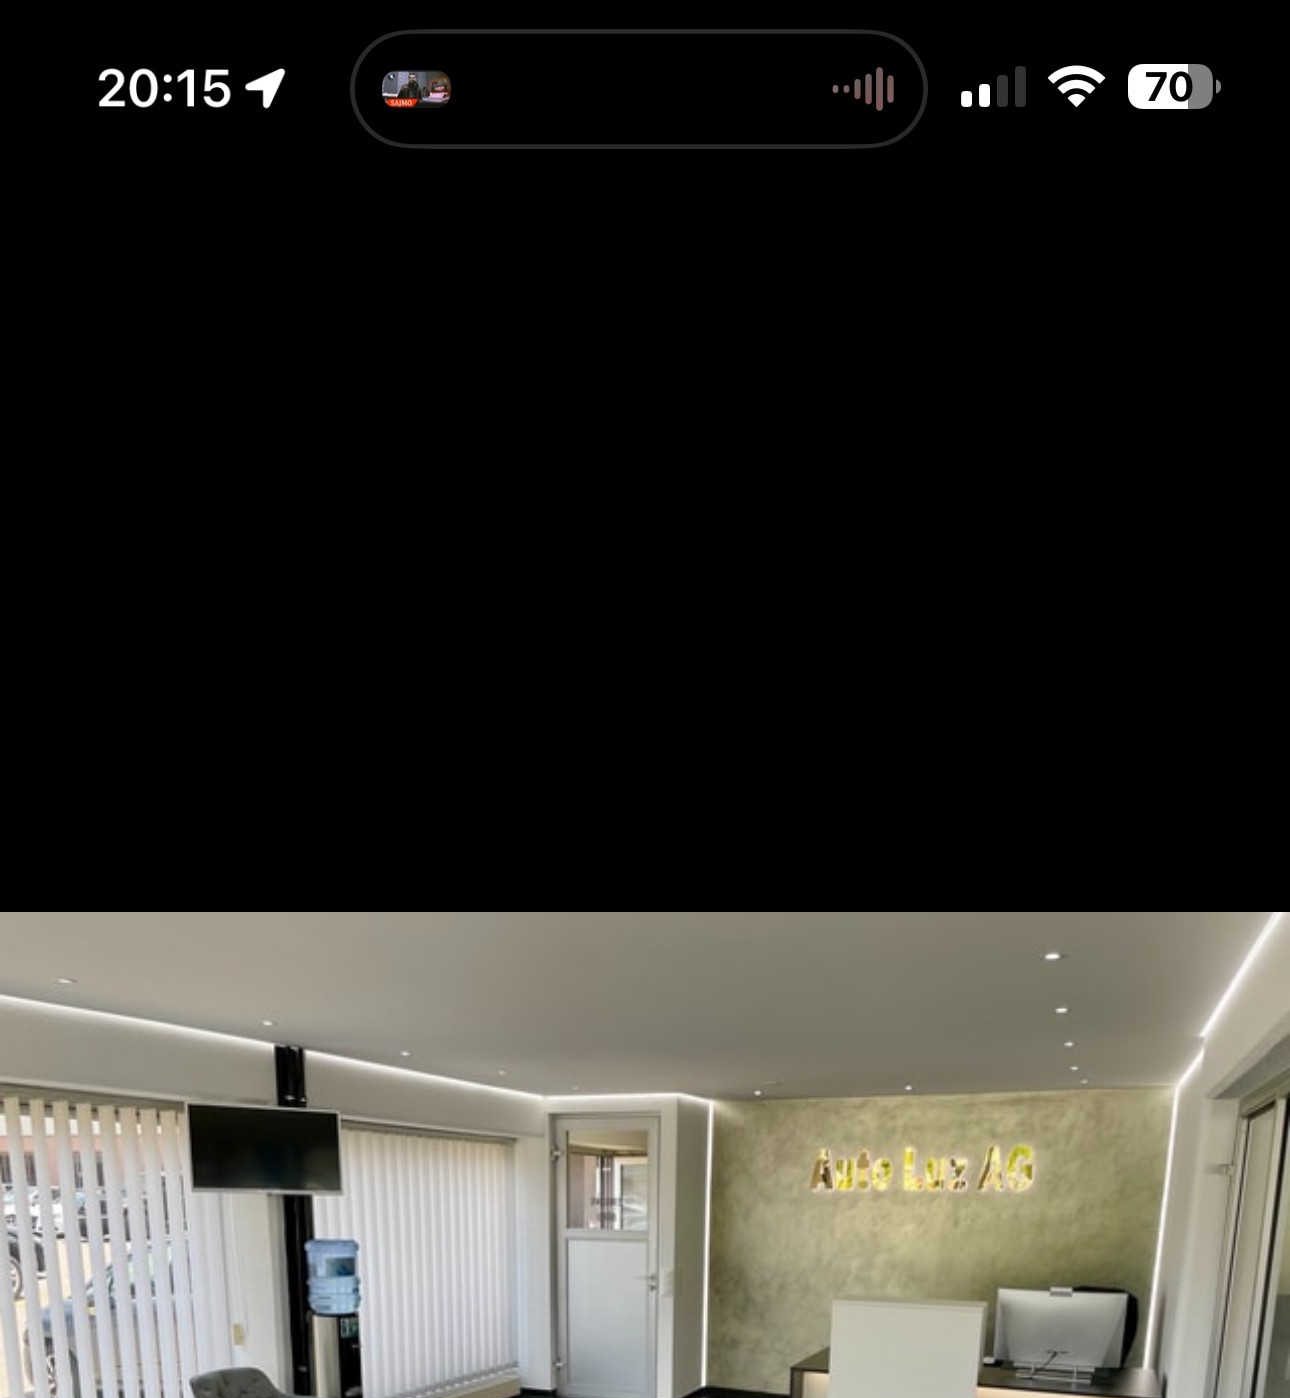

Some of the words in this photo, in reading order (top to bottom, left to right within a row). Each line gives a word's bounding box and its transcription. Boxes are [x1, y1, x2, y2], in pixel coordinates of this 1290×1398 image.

[811, 1149, 893, 1191] Auto
[903, 1147, 967, 1191] Luz
[979, 1144, 1034, 1191] AG
